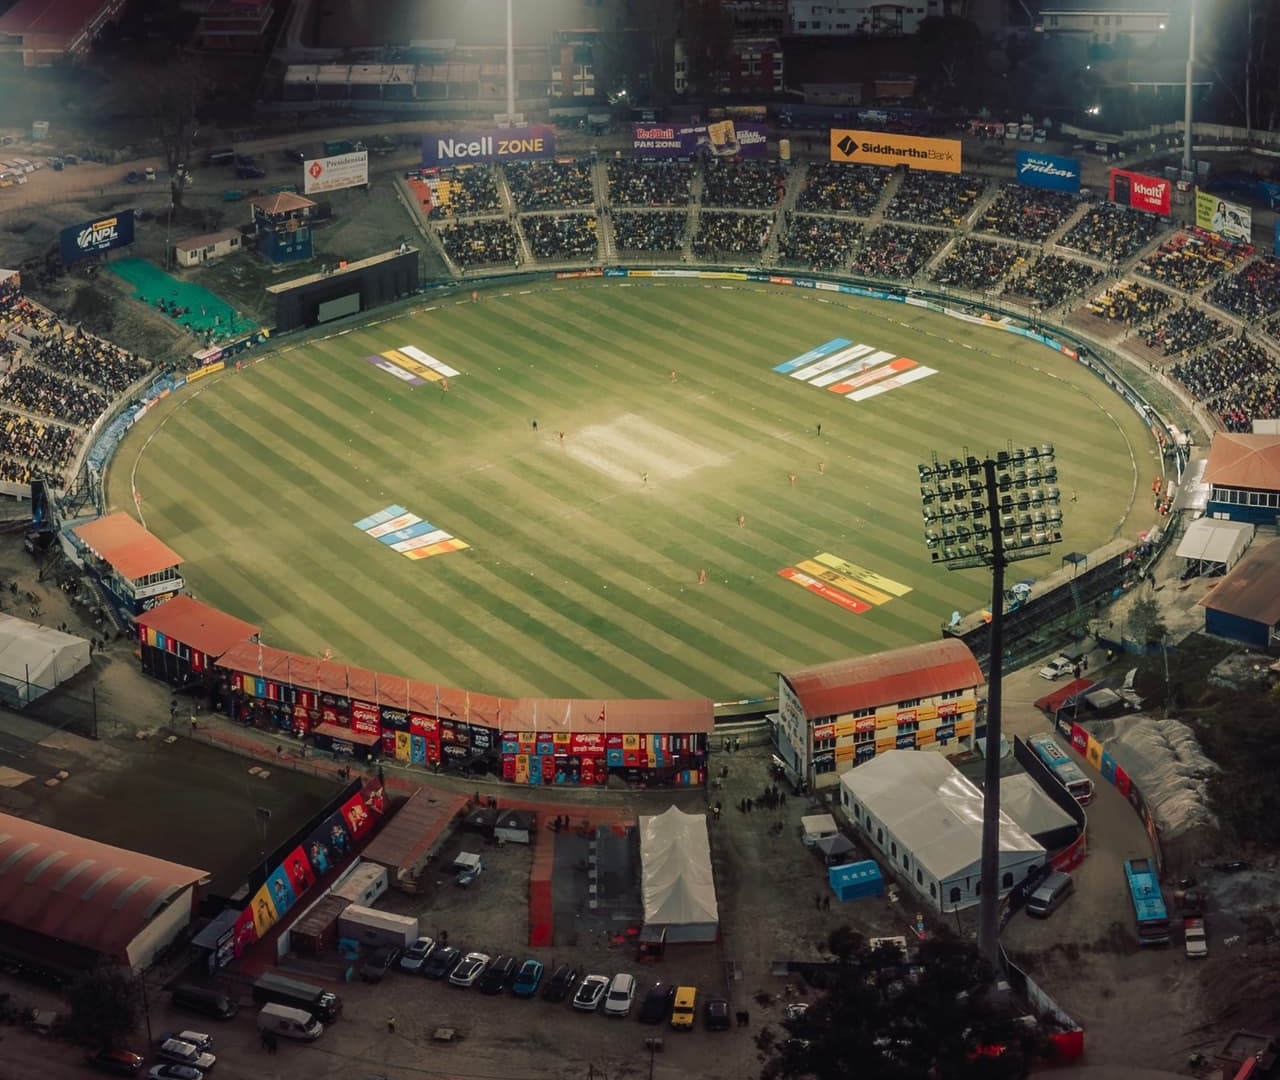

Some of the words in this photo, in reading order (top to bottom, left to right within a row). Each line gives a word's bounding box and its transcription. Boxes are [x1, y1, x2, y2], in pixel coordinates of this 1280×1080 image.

[438, 136, 493, 159] Ncell
[498, 138, 543, 155] ZONE
[634, 141, 655, 149] FAN
[655, 141, 681, 149] ZONE
[1134, 182, 1164, 199] khalti
[92, 226, 118, 243] NPL
